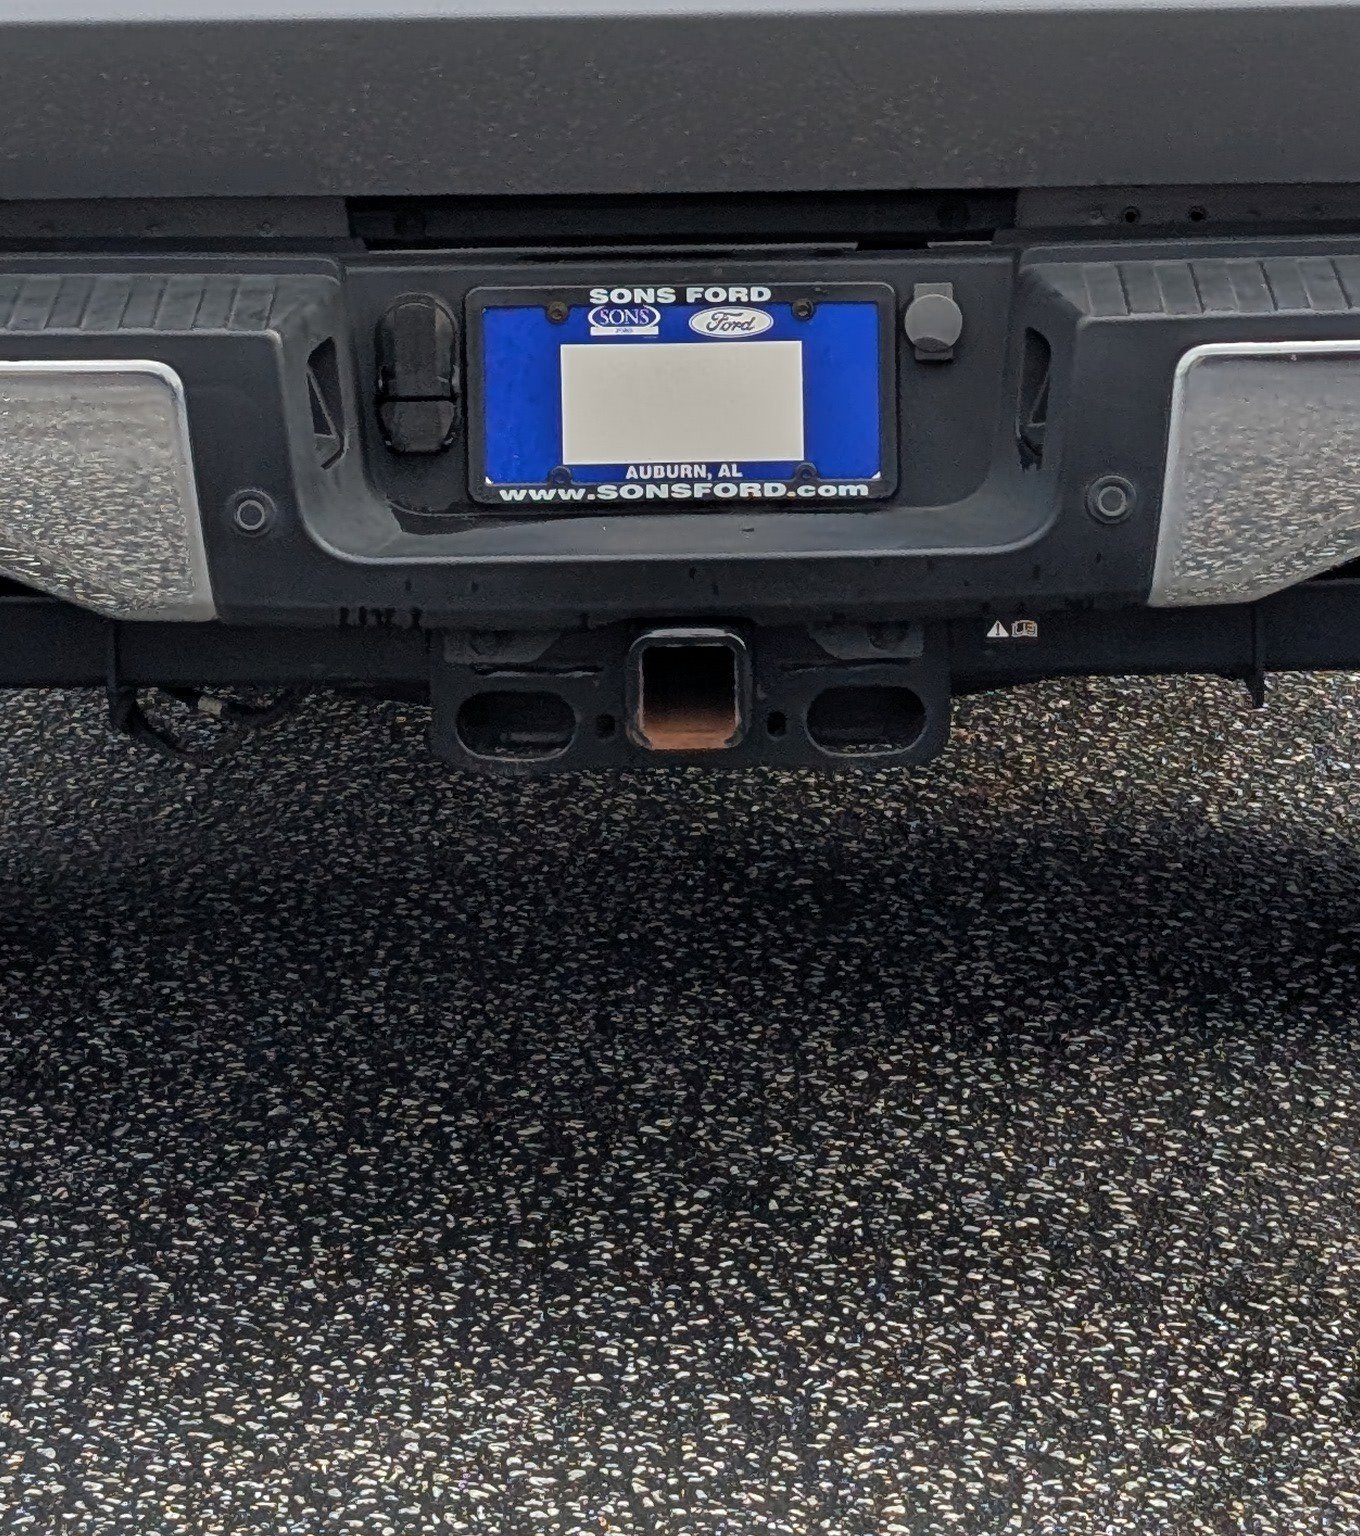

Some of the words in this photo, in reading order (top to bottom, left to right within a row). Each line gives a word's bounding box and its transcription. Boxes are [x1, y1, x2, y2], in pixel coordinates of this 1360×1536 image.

[589, 287, 677, 304] SONS
[685, 286, 772, 303] FORD
[599, 308, 650, 326] SONS
[705, 311, 756, 333] Ford
[625, 464, 713, 481] AUBURN,
[718, 464, 743, 479] AL
[499, 481, 870, 502] www.SONSFORD.com
